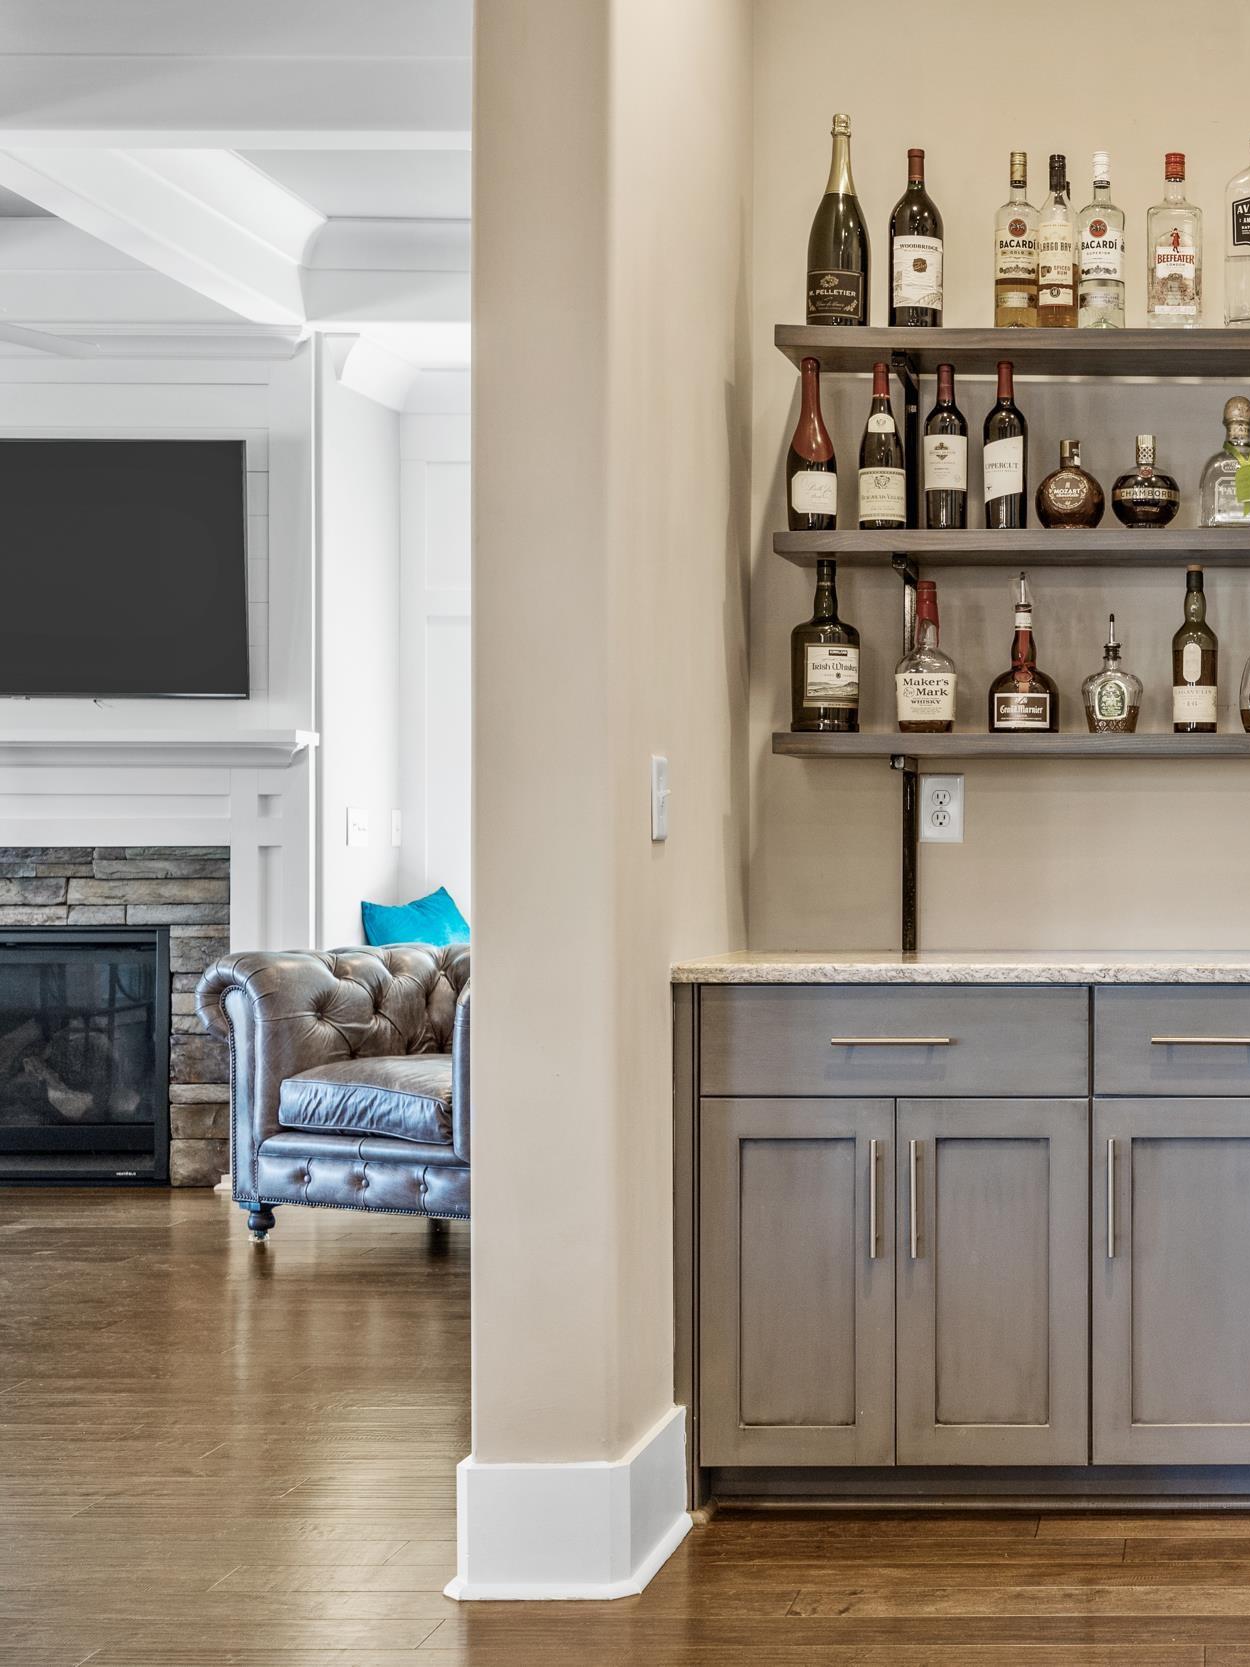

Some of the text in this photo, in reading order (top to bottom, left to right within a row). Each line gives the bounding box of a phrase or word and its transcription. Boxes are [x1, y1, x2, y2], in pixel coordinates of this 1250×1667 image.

[899, 243, 938, 251] WOODBRIDGE
[1157, 253, 1195, 264] BEEFEATER
[815, 289, 857, 298] PELLETIER
[1120, 489, 1173, 499] CHAMBORD
[812, 662, 831, 671] Irish
[903, 678, 949, 686] Maker's
[916, 687, 949, 696] Mark
